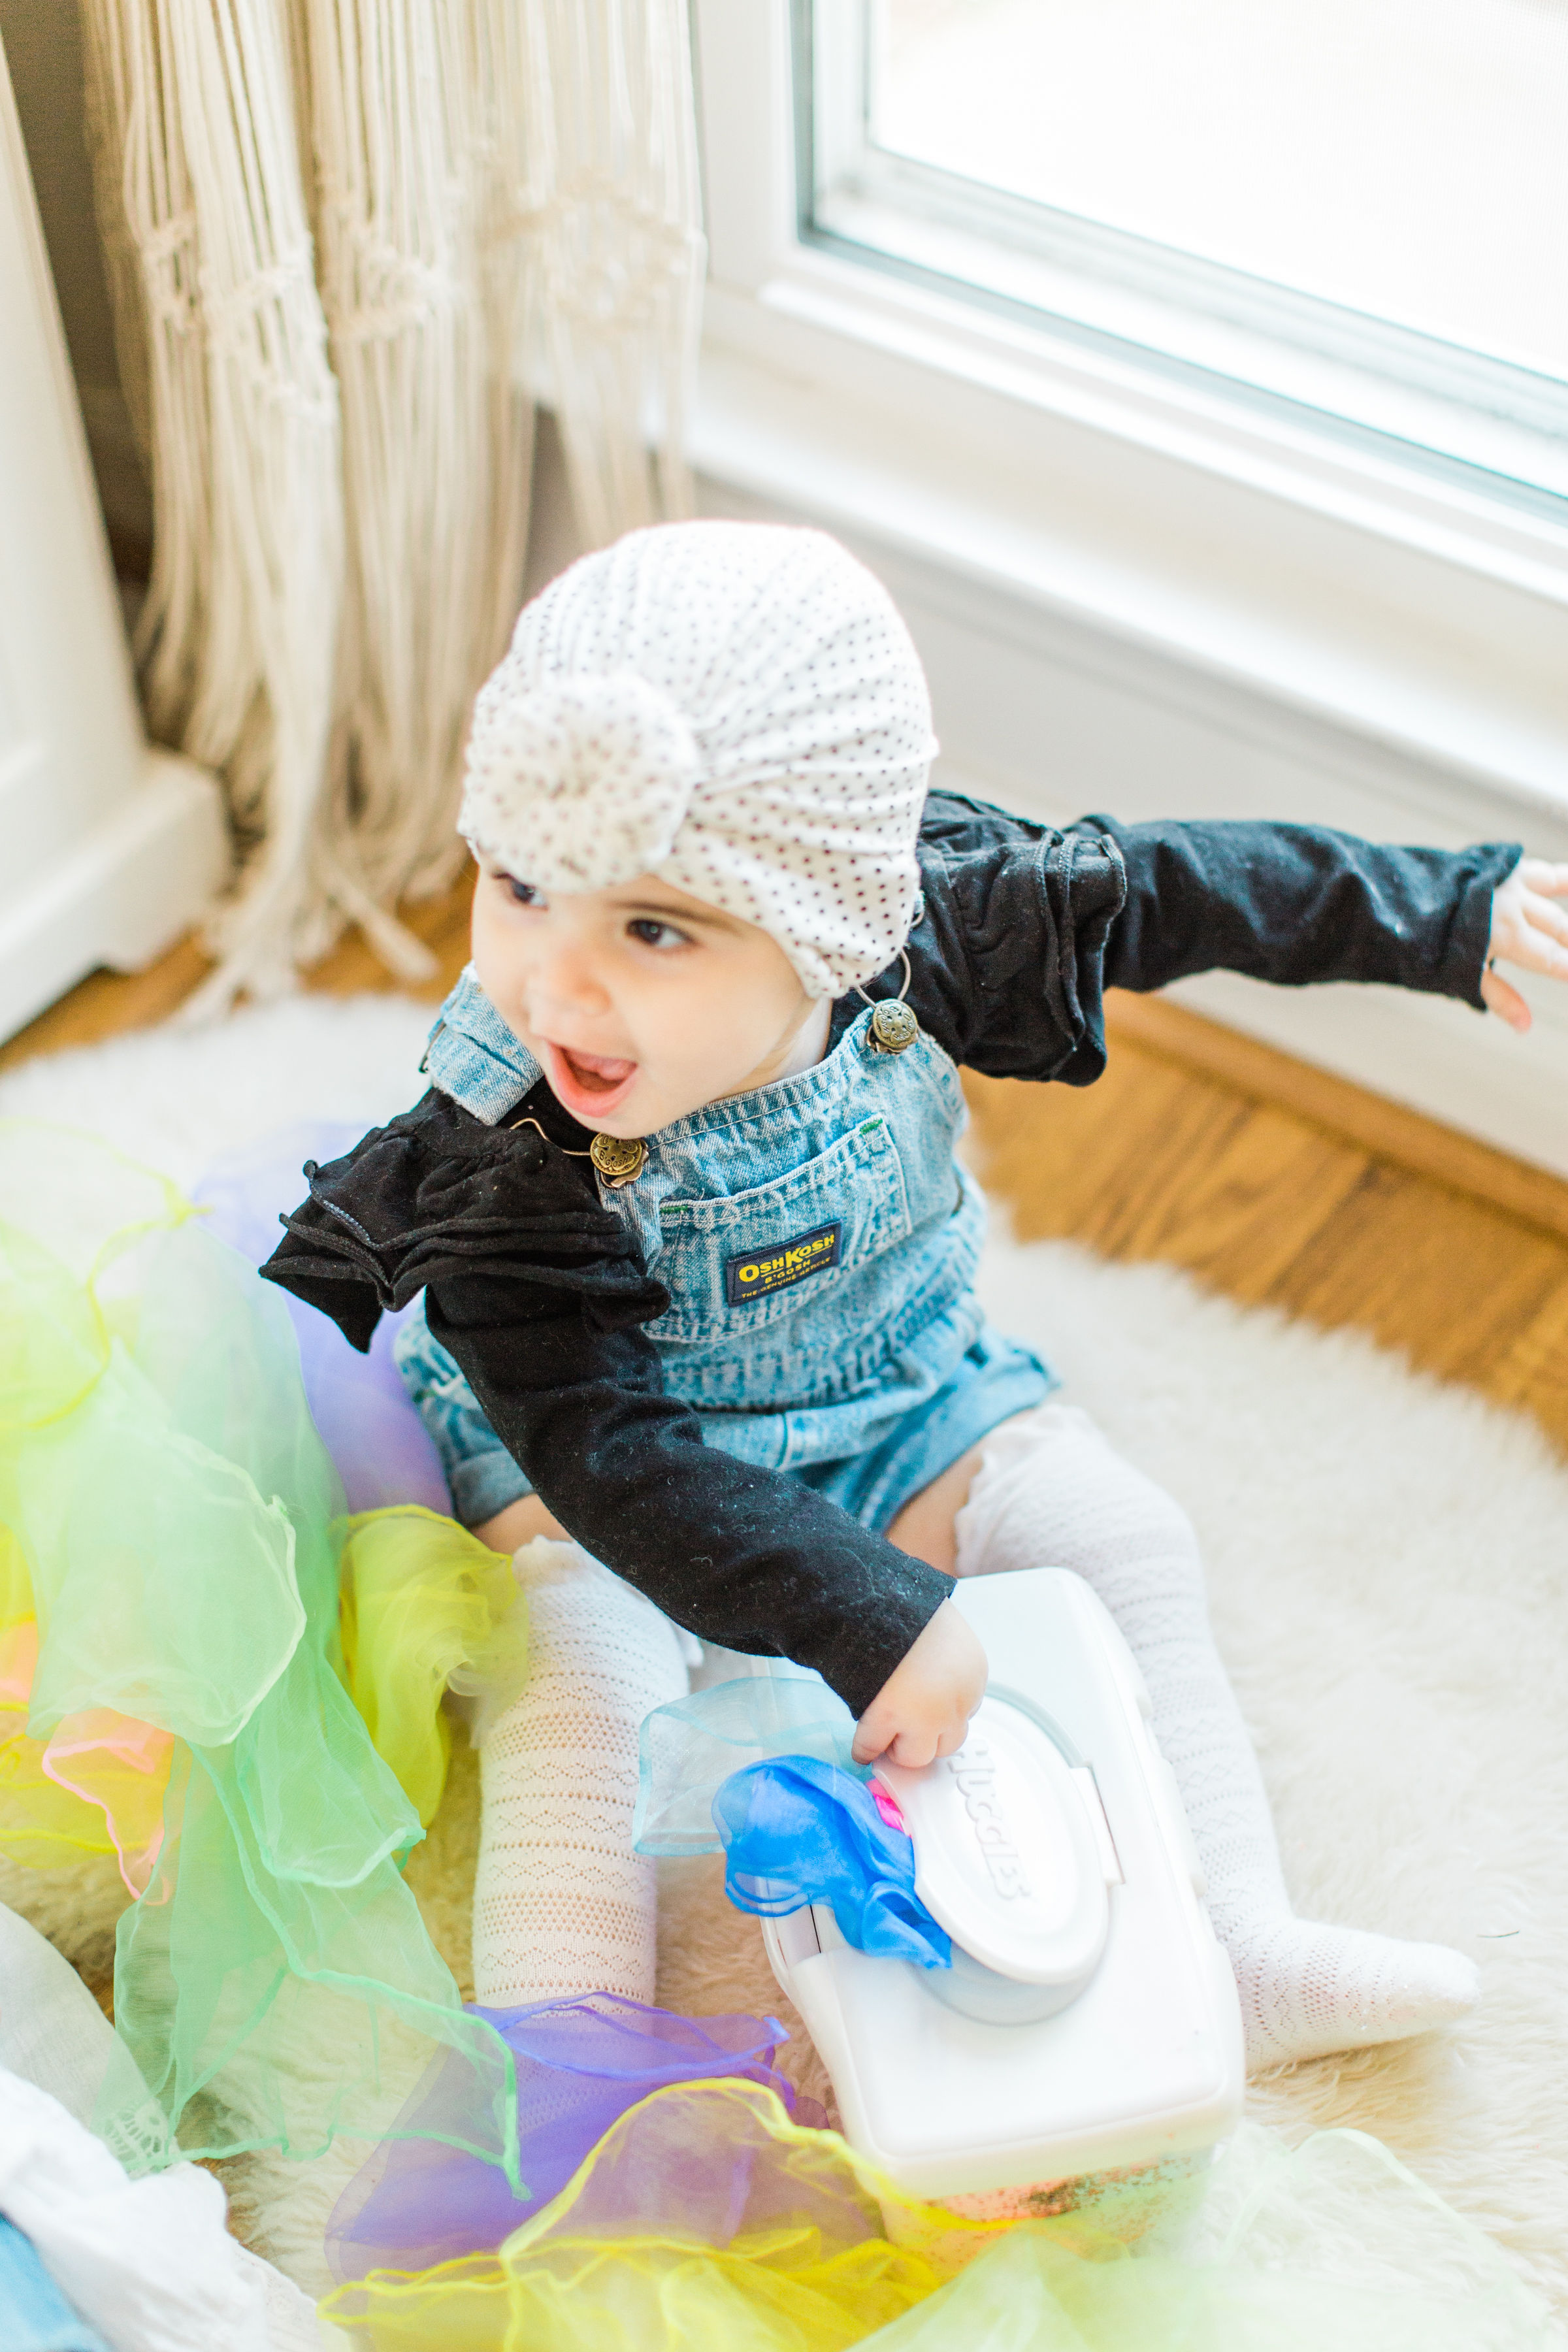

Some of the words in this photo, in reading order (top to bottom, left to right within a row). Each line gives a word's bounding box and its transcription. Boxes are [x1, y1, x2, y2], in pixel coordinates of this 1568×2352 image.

[760, 1275, 796, 1292] GENUINE
[799, 1256, 831, 1276] ARTICLE
[764, 1260, 810, 1284] B'GOSH
[948, 1735, 1033, 1901] HUGGIES
